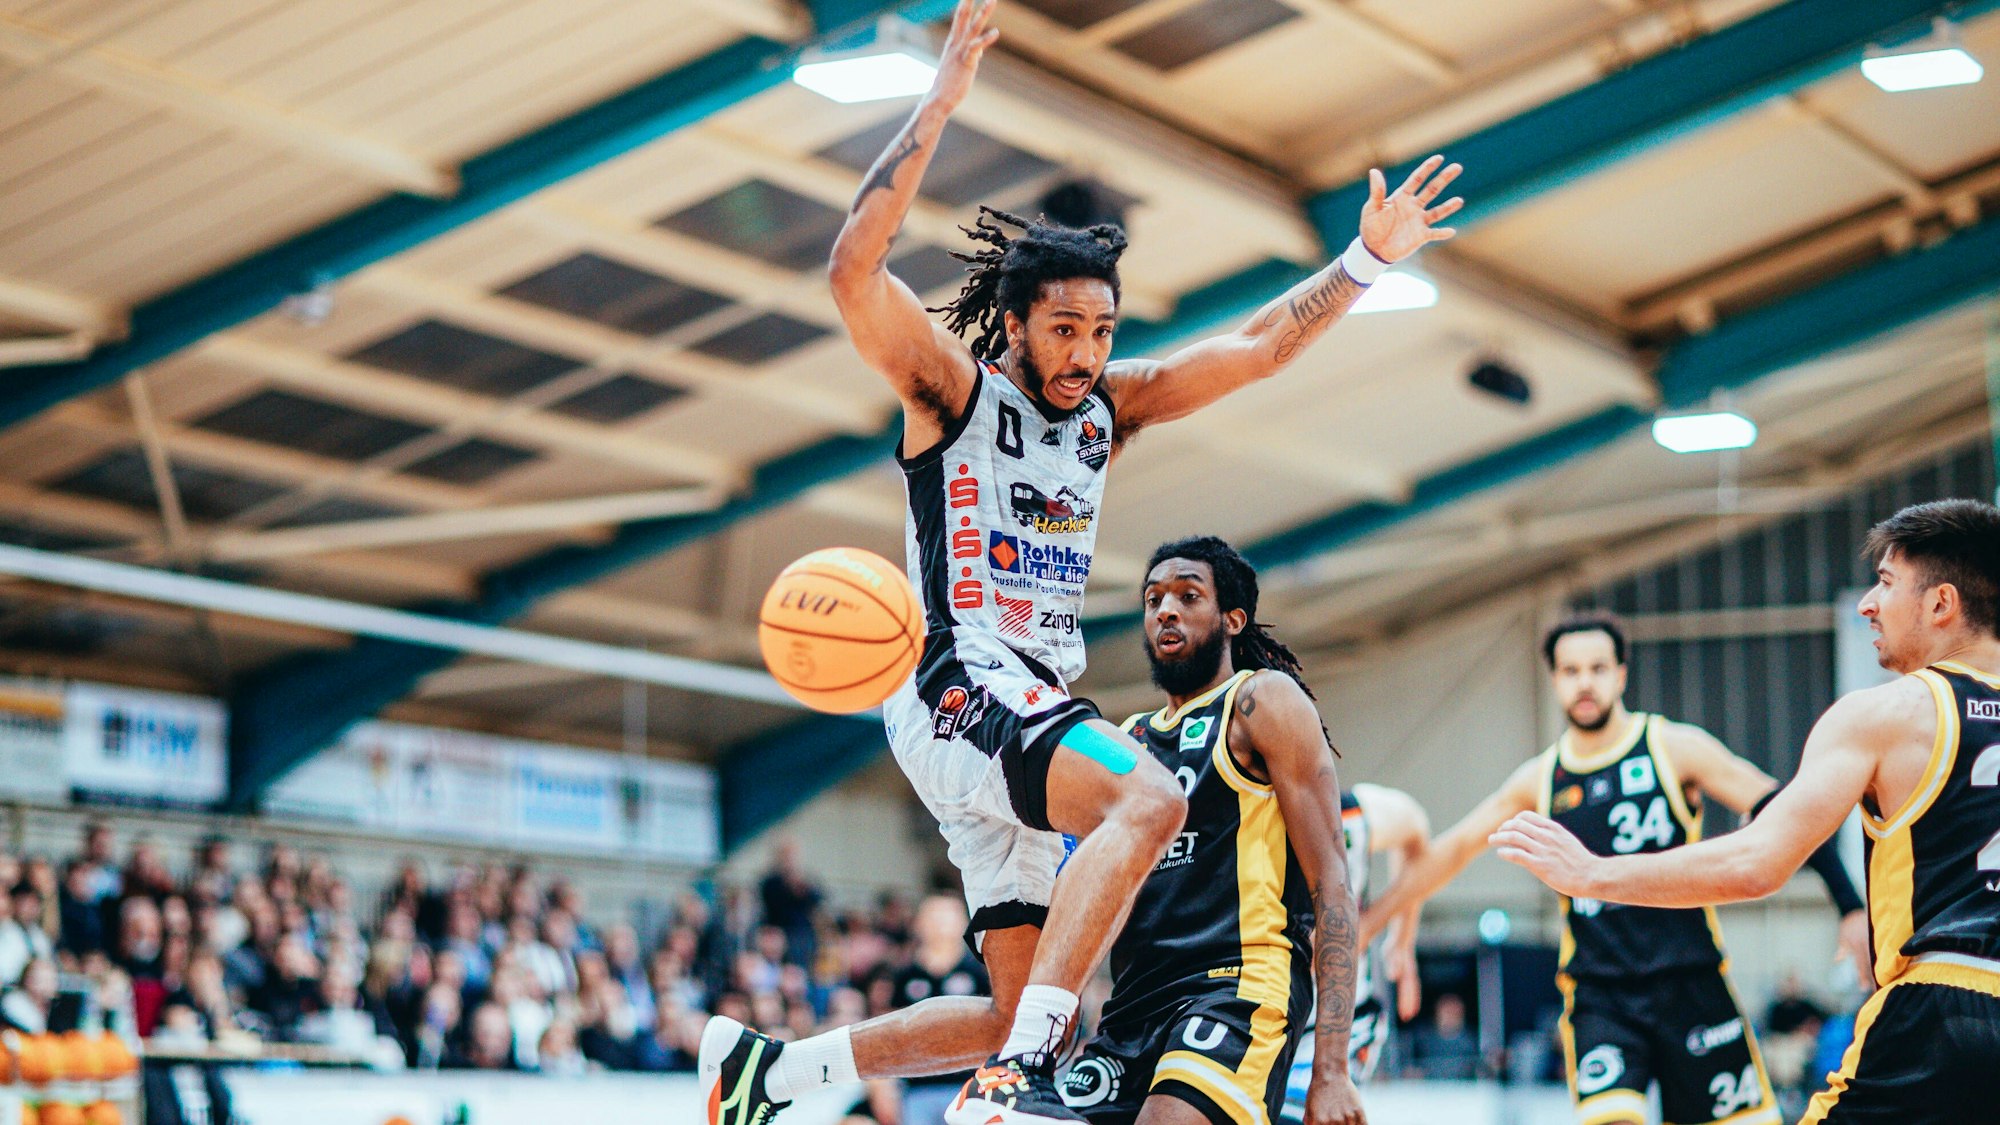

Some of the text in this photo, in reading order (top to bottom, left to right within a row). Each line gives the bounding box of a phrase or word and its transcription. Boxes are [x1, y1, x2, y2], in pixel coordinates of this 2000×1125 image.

[1080, 442, 1109, 459] SIXERS
[1034, 515, 1091, 534] Herker
[1041, 564, 1062, 581] alle
[1608, 796, 1675, 853] 34
[1709, 1063, 1763, 1118] 34
